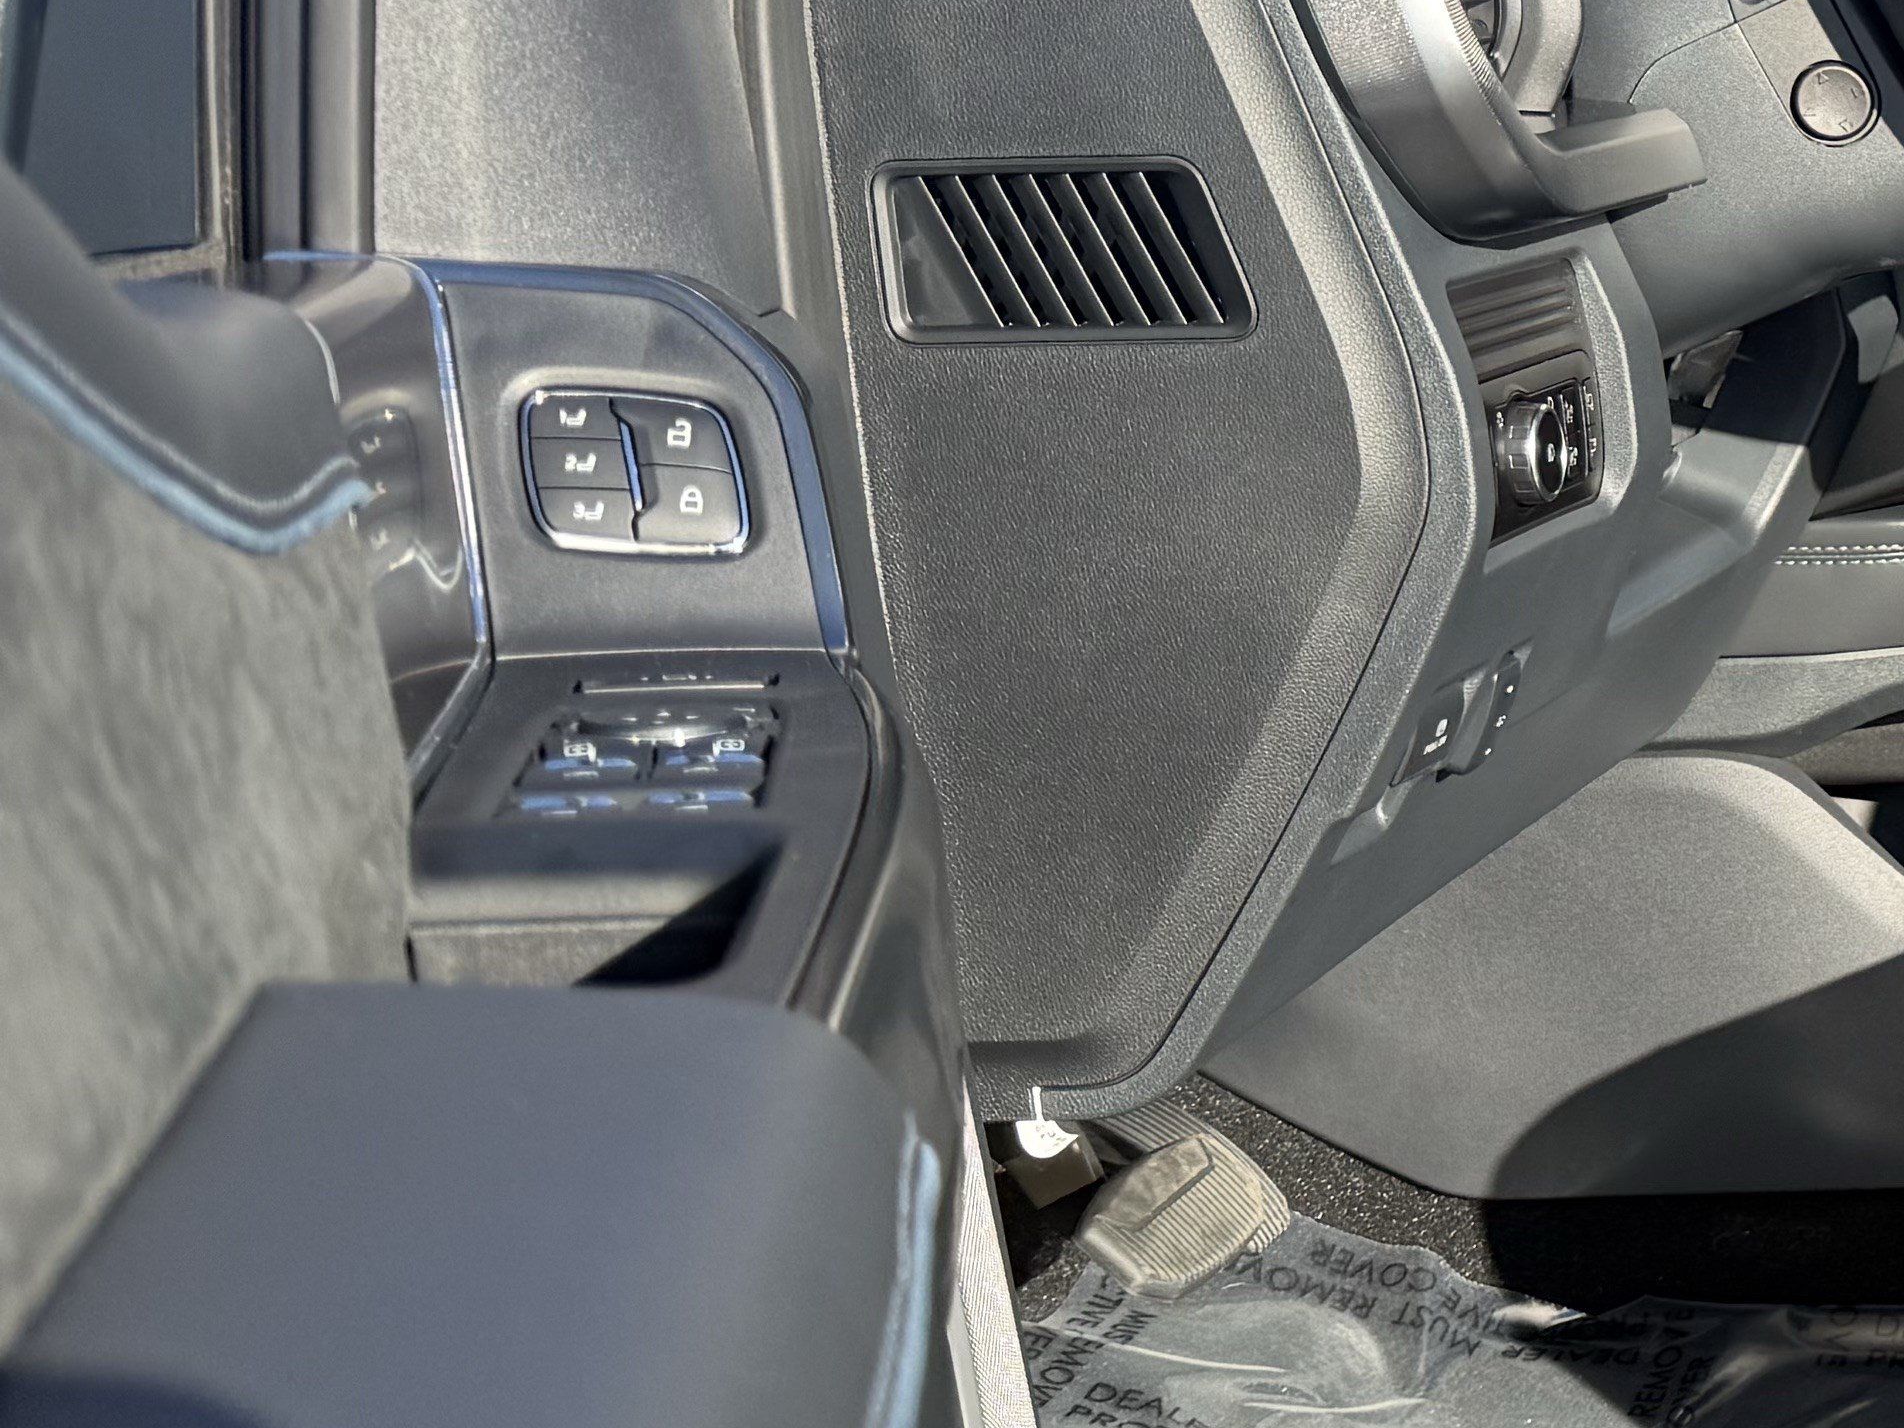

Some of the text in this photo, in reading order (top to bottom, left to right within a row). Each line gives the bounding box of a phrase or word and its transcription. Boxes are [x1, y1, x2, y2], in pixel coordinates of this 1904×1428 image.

[1239, 1253, 1377, 1320] REMOV
[1308, 1239, 1437, 1292] COVER
[1391, 1301, 1481, 1358] MUST
